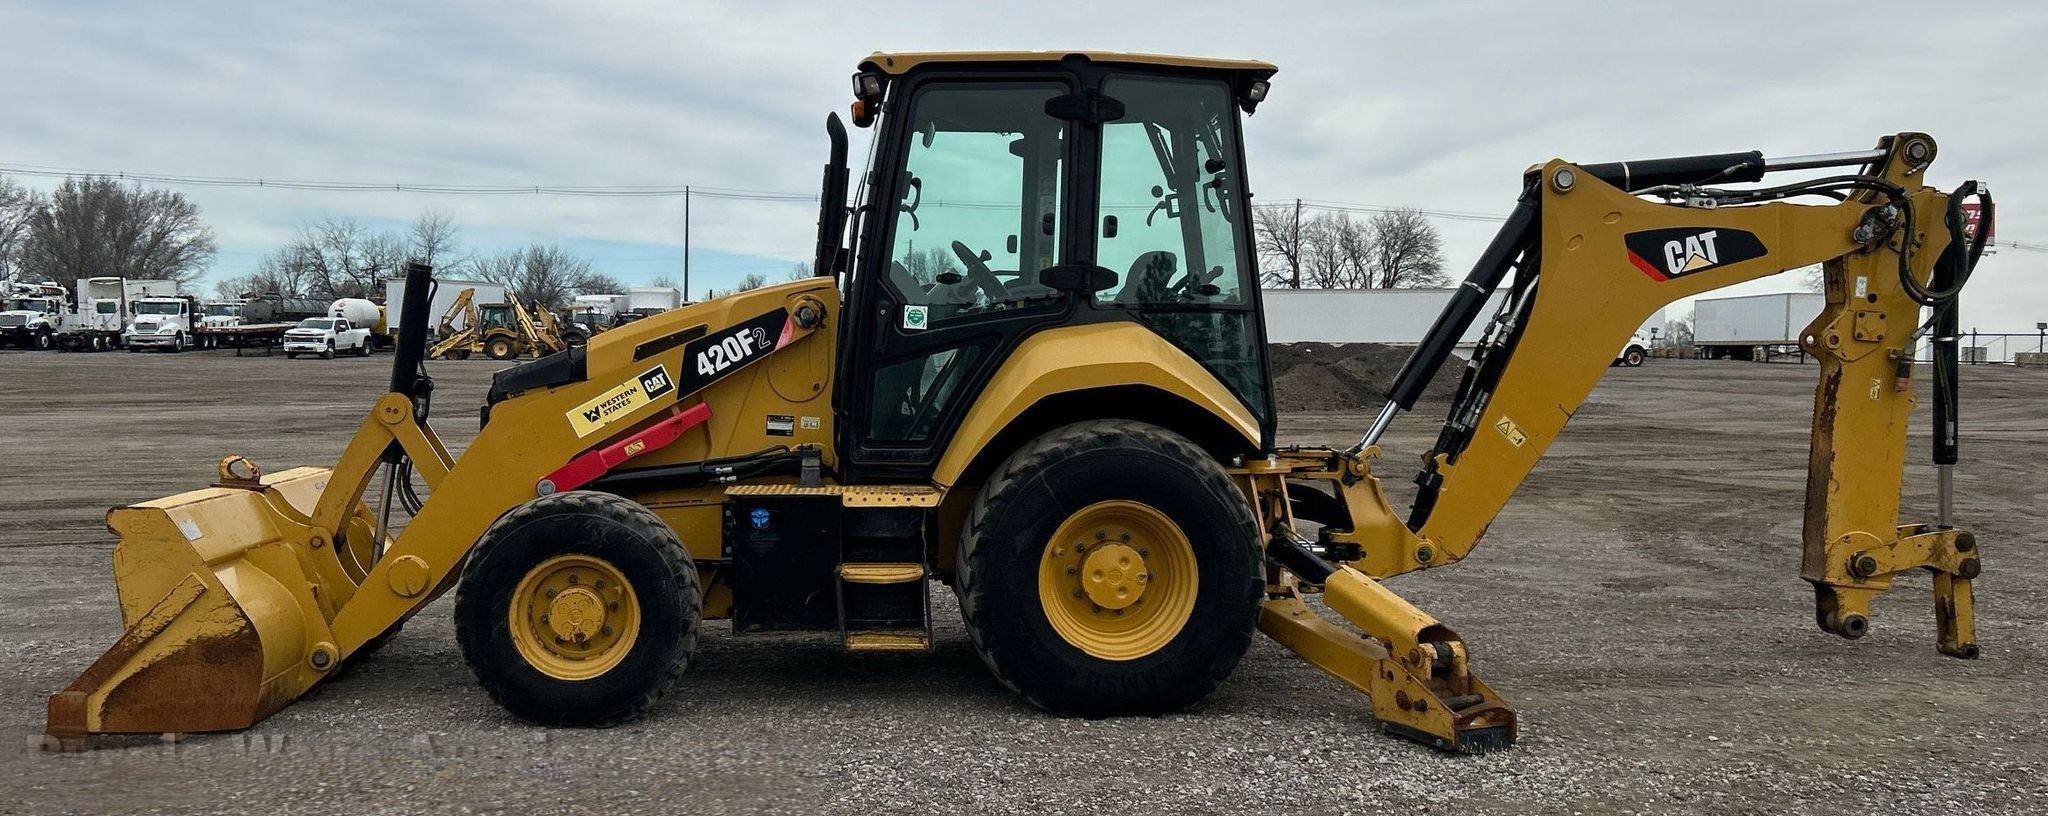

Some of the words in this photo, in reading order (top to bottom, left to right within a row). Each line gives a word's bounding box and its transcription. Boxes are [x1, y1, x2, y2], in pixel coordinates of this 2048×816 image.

[1663, 230, 1719, 275] CAT
[644, 372, 667, 393] CAT
[600, 386, 638, 410] WESTERN
[603, 398, 632, 417] STATES
